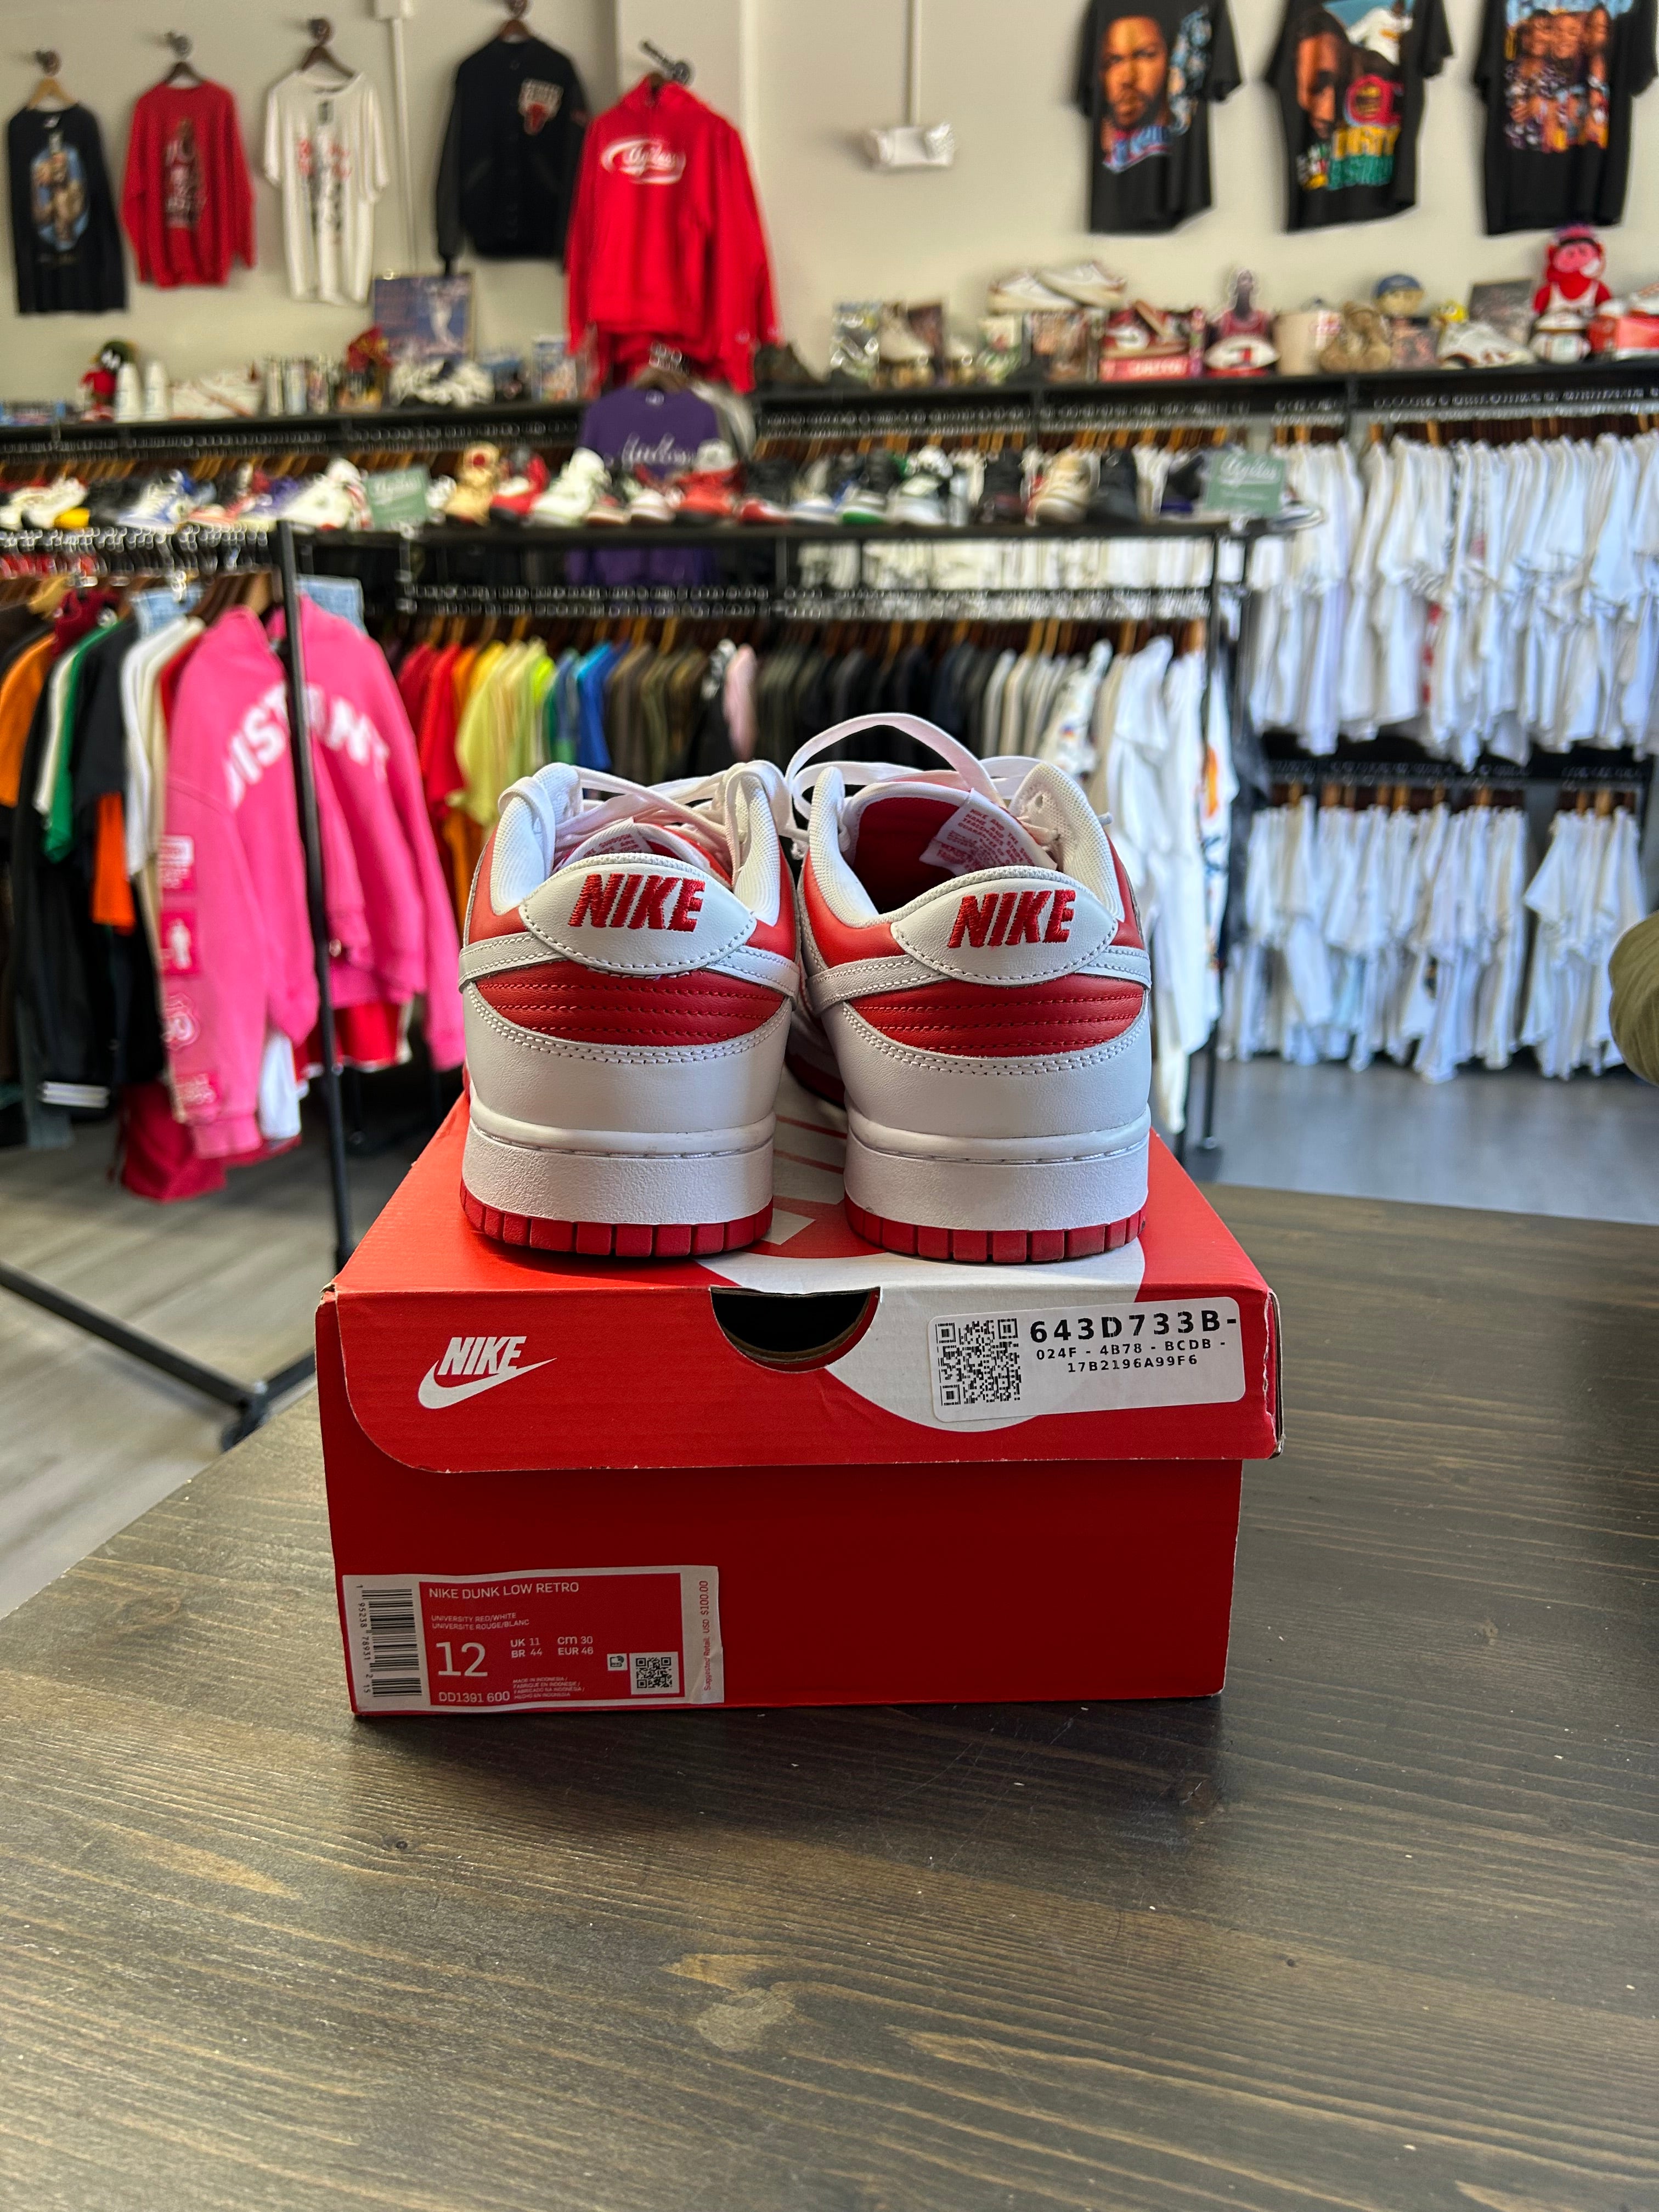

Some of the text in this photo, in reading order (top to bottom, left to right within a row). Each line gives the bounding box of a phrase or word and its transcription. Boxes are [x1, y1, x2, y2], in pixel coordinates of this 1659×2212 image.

[568, 873, 706, 933] NIKE
[947, 889, 1076, 949] NIKE
[437, 1336, 527, 1375] NIKE
[1100, 1343, 1143, 1356] 4B78
[1165, 1339, 1211, 1352] BCDB
[1067, 1355, 1198, 1373] 17B2196A99F6
[429, 1582, 579, 1599] NIKE DUNK LOW RETRO
[699, 1581, 709, 1615] $100.00
[358, 1602, 367, 1628] 95238
[431, 1612, 517, 1623] UNIVERSITY RED/WHITE
[476, 1619, 530, 1630] ROUGE/BLANC
[362, 1636, 371, 1660] 78931
[510, 1637, 540, 1647] UK 11
[580, 1635, 593, 1645] 30
[436, 1641, 488, 1677] 12
[511, 1647, 543, 1658] BR 44
[557, 1647, 579, 1656] EUR
[704, 1657, 712, 1691] Suggested
[439, 1691, 510, 1703] DD1391 600
